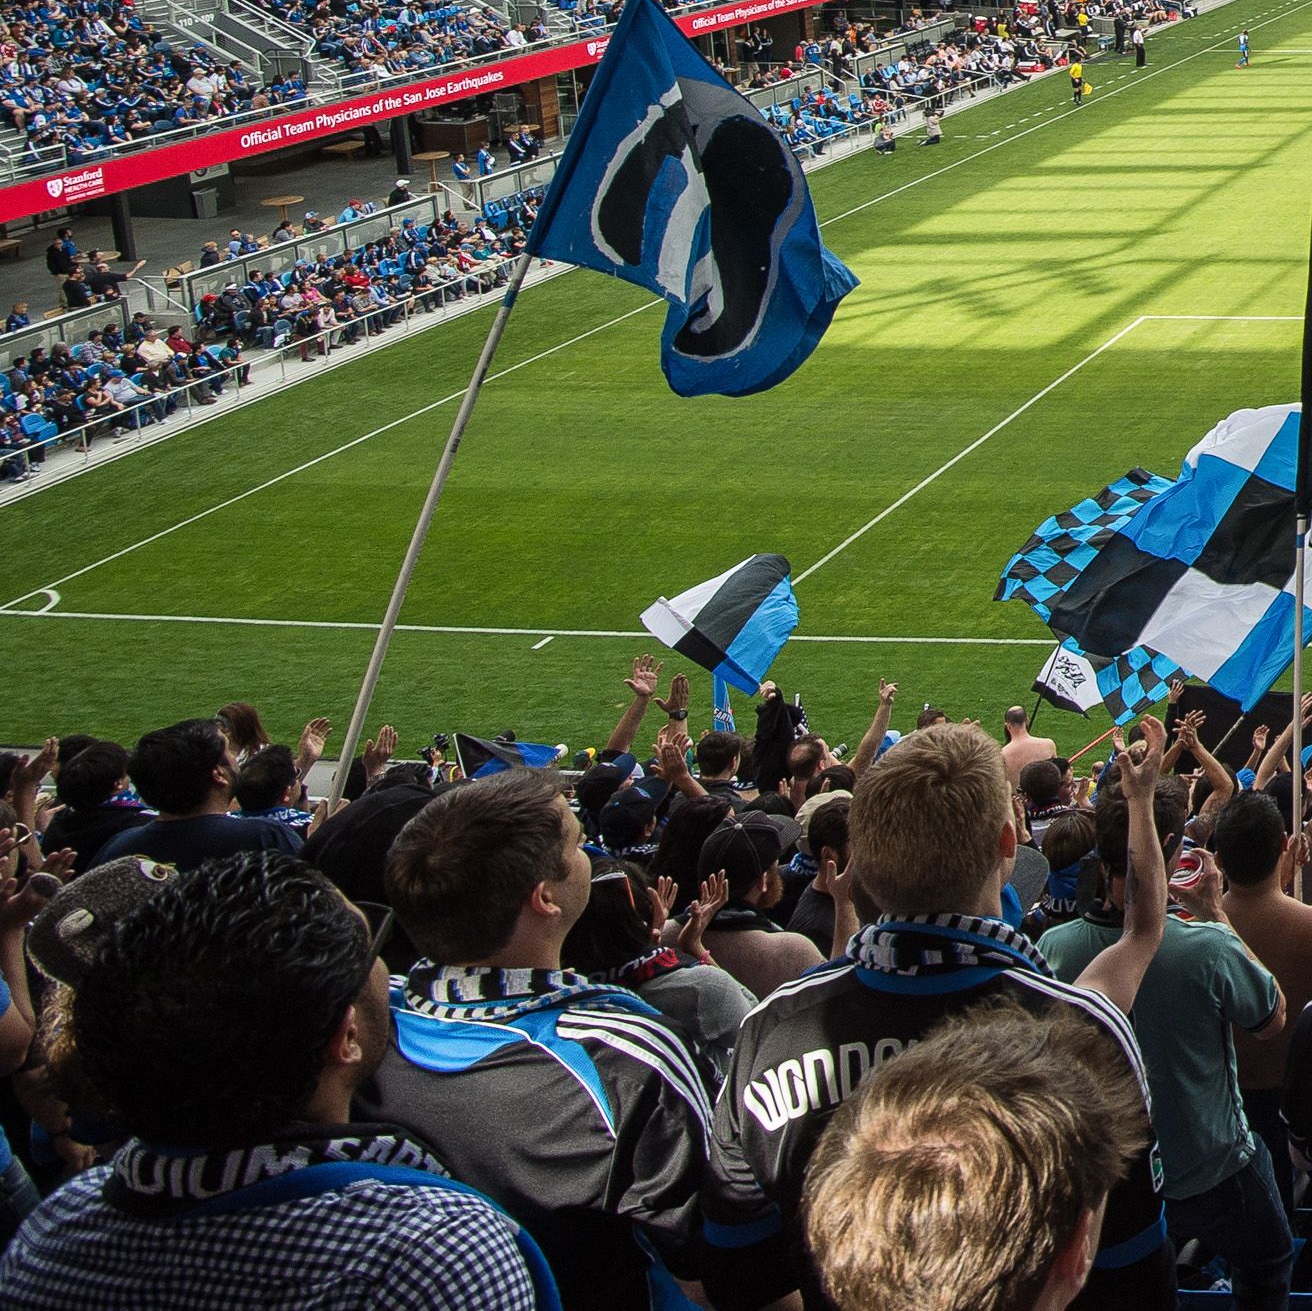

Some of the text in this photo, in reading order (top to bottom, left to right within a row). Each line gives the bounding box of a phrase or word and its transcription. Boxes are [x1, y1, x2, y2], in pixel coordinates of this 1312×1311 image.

[692, 14, 717, 31] Official
[717, 10, 735, 24] Team
[735, 2, 769, 22] Physicians
[241, 71, 505, 149] Official Team Physicians of the San Jose Earthquakes
[63, 168, 103, 187] Stanford
